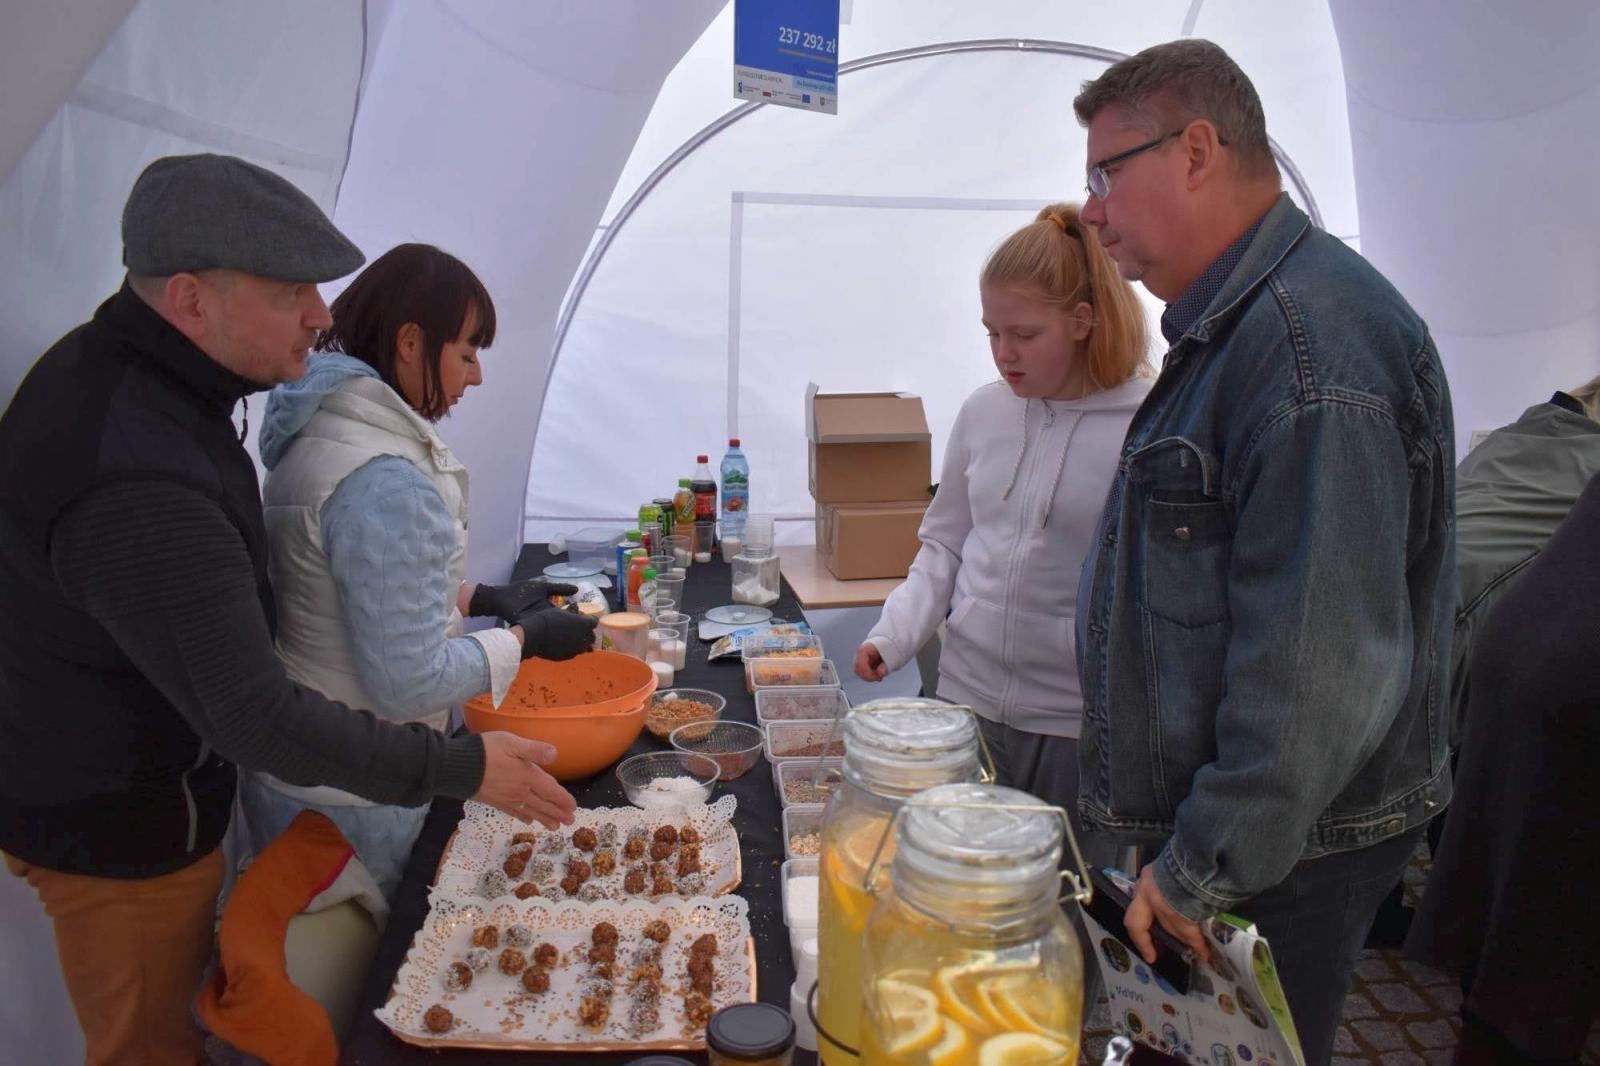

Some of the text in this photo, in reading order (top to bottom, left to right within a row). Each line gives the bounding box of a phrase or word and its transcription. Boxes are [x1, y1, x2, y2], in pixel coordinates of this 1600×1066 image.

[779, 26, 836, 54] 237 292 zł
